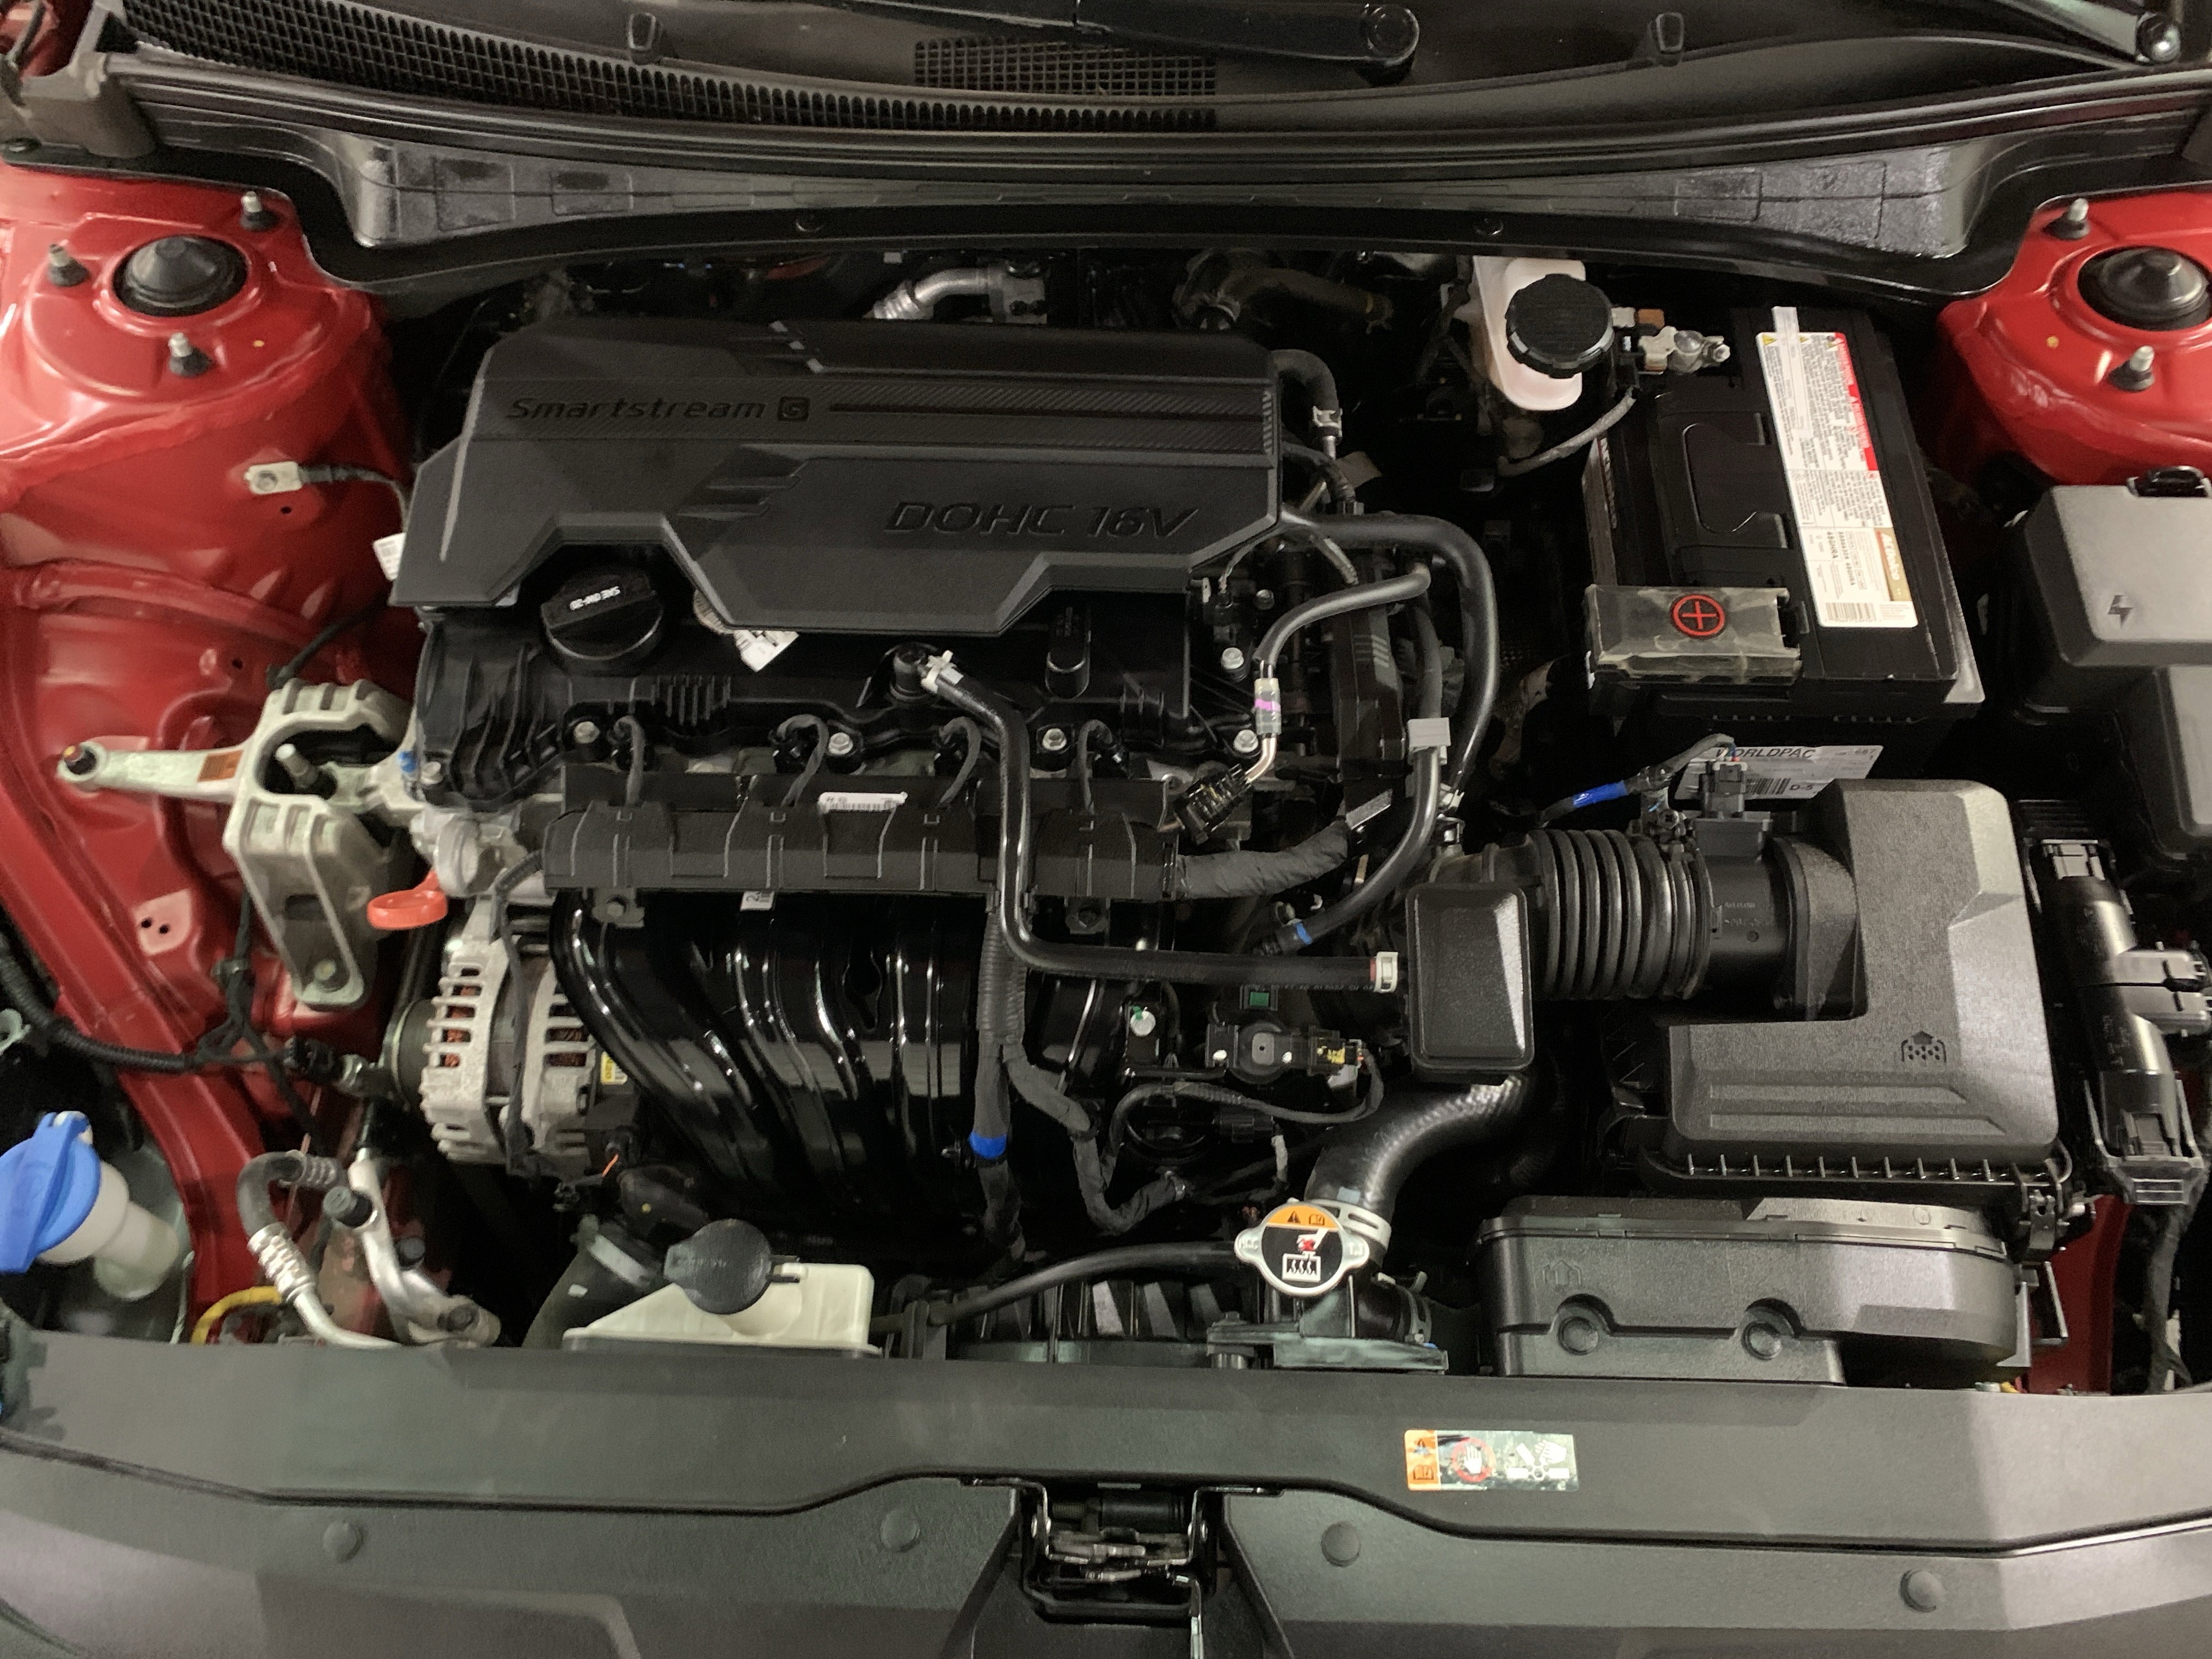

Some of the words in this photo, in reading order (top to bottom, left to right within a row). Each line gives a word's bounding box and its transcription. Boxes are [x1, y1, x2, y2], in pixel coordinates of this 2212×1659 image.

[506, 396, 765, 421] Smartstream
[884, 501, 1076, 537] DOHC
[1089, 506, 1199, 539] 16V
